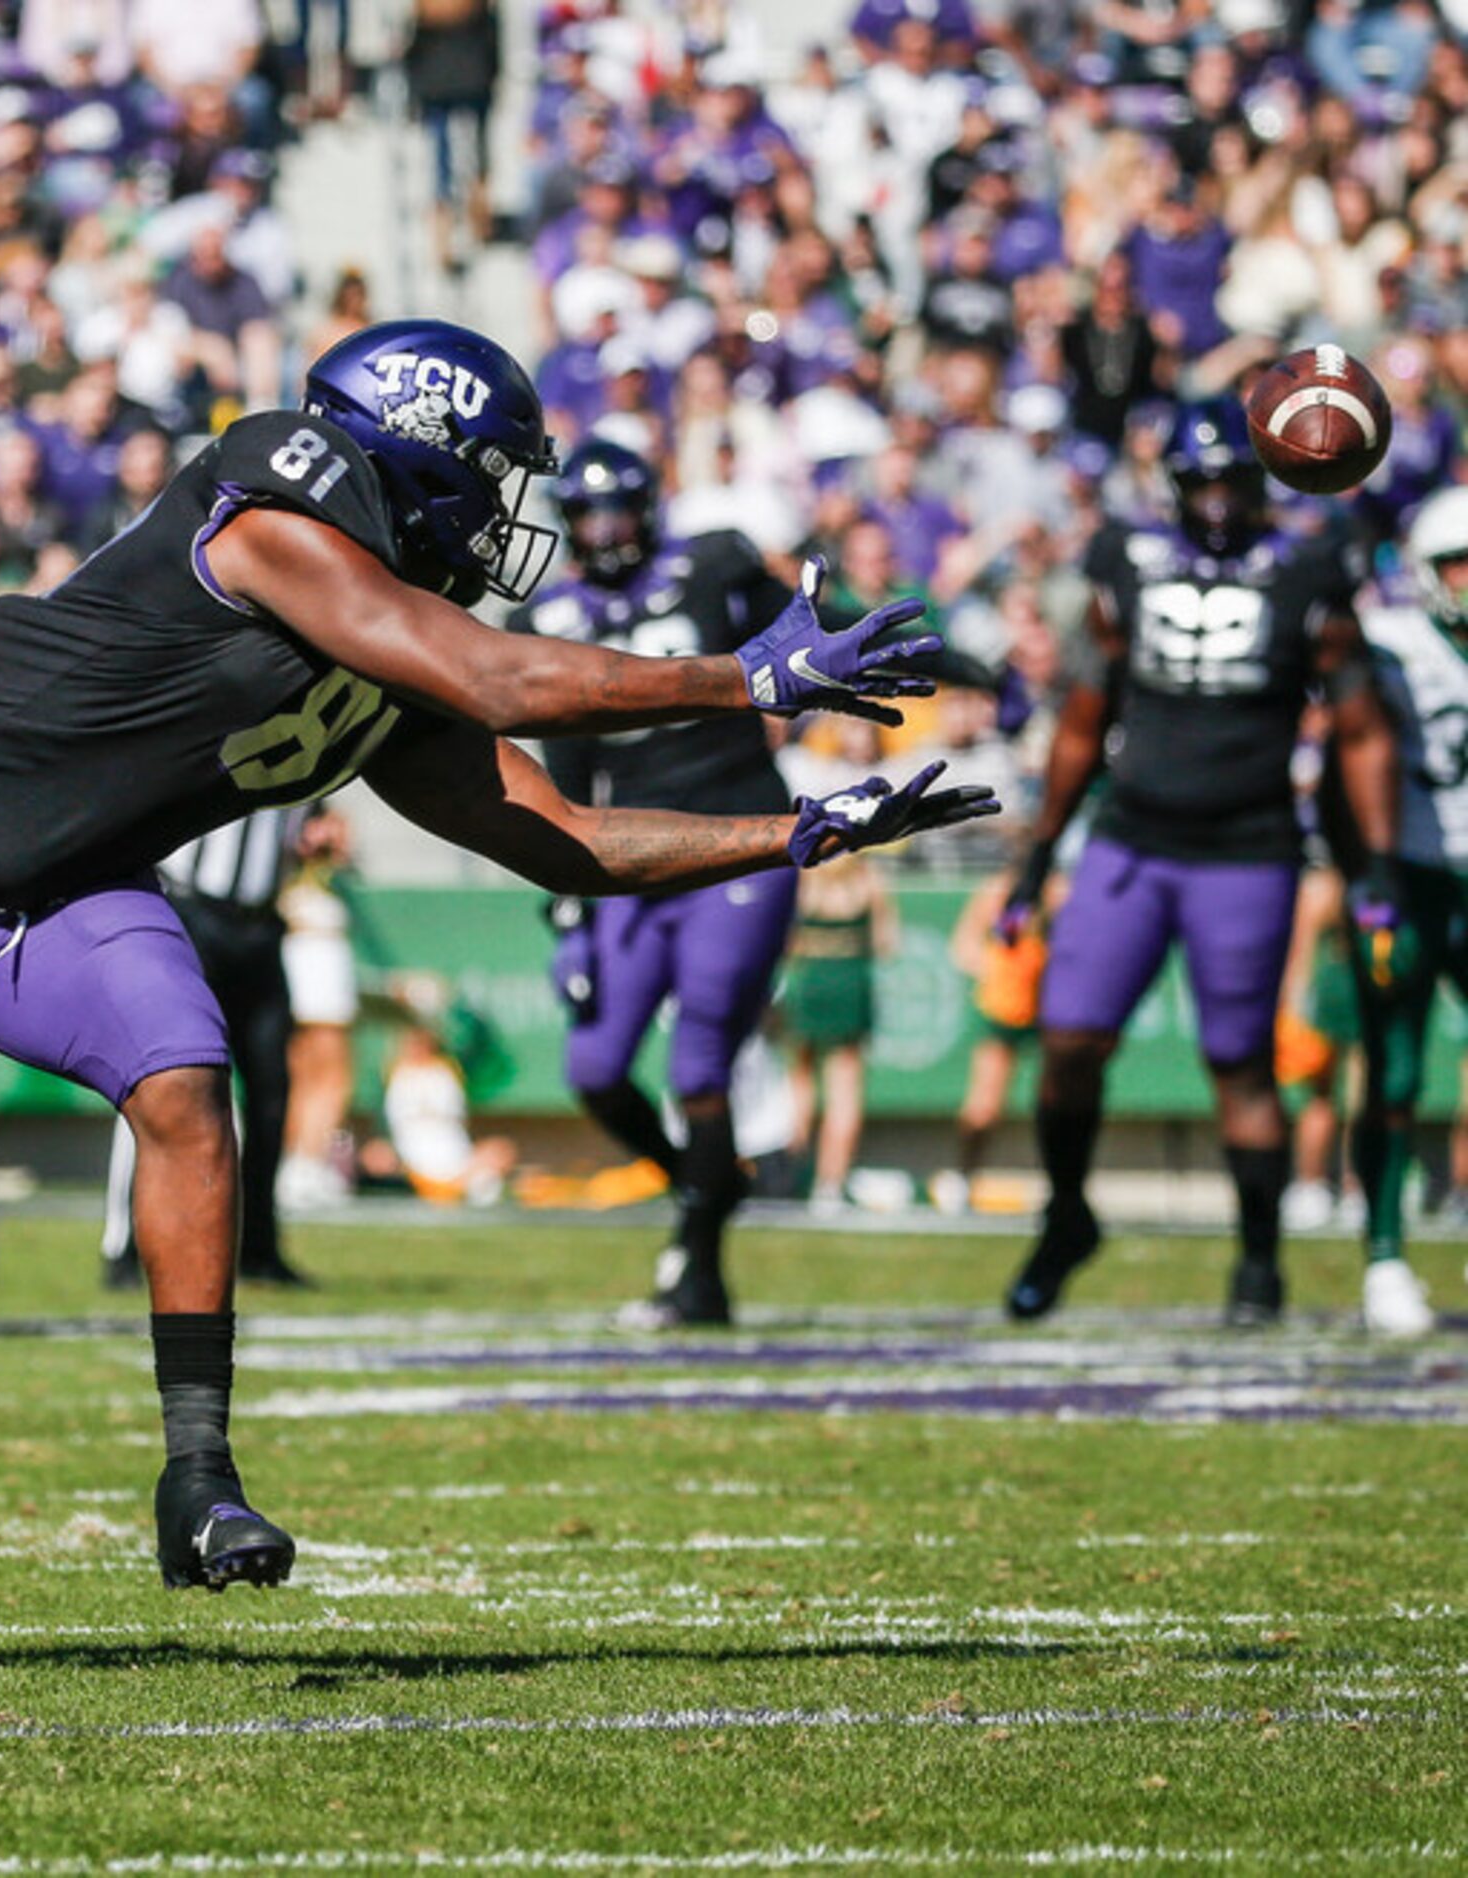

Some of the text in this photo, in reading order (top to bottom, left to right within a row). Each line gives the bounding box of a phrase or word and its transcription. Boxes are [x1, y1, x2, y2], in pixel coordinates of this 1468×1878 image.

[374, 352, 492, 420] TCU
[268, 427, 351, 504] 81
[218, 665, 402, 812] 81
